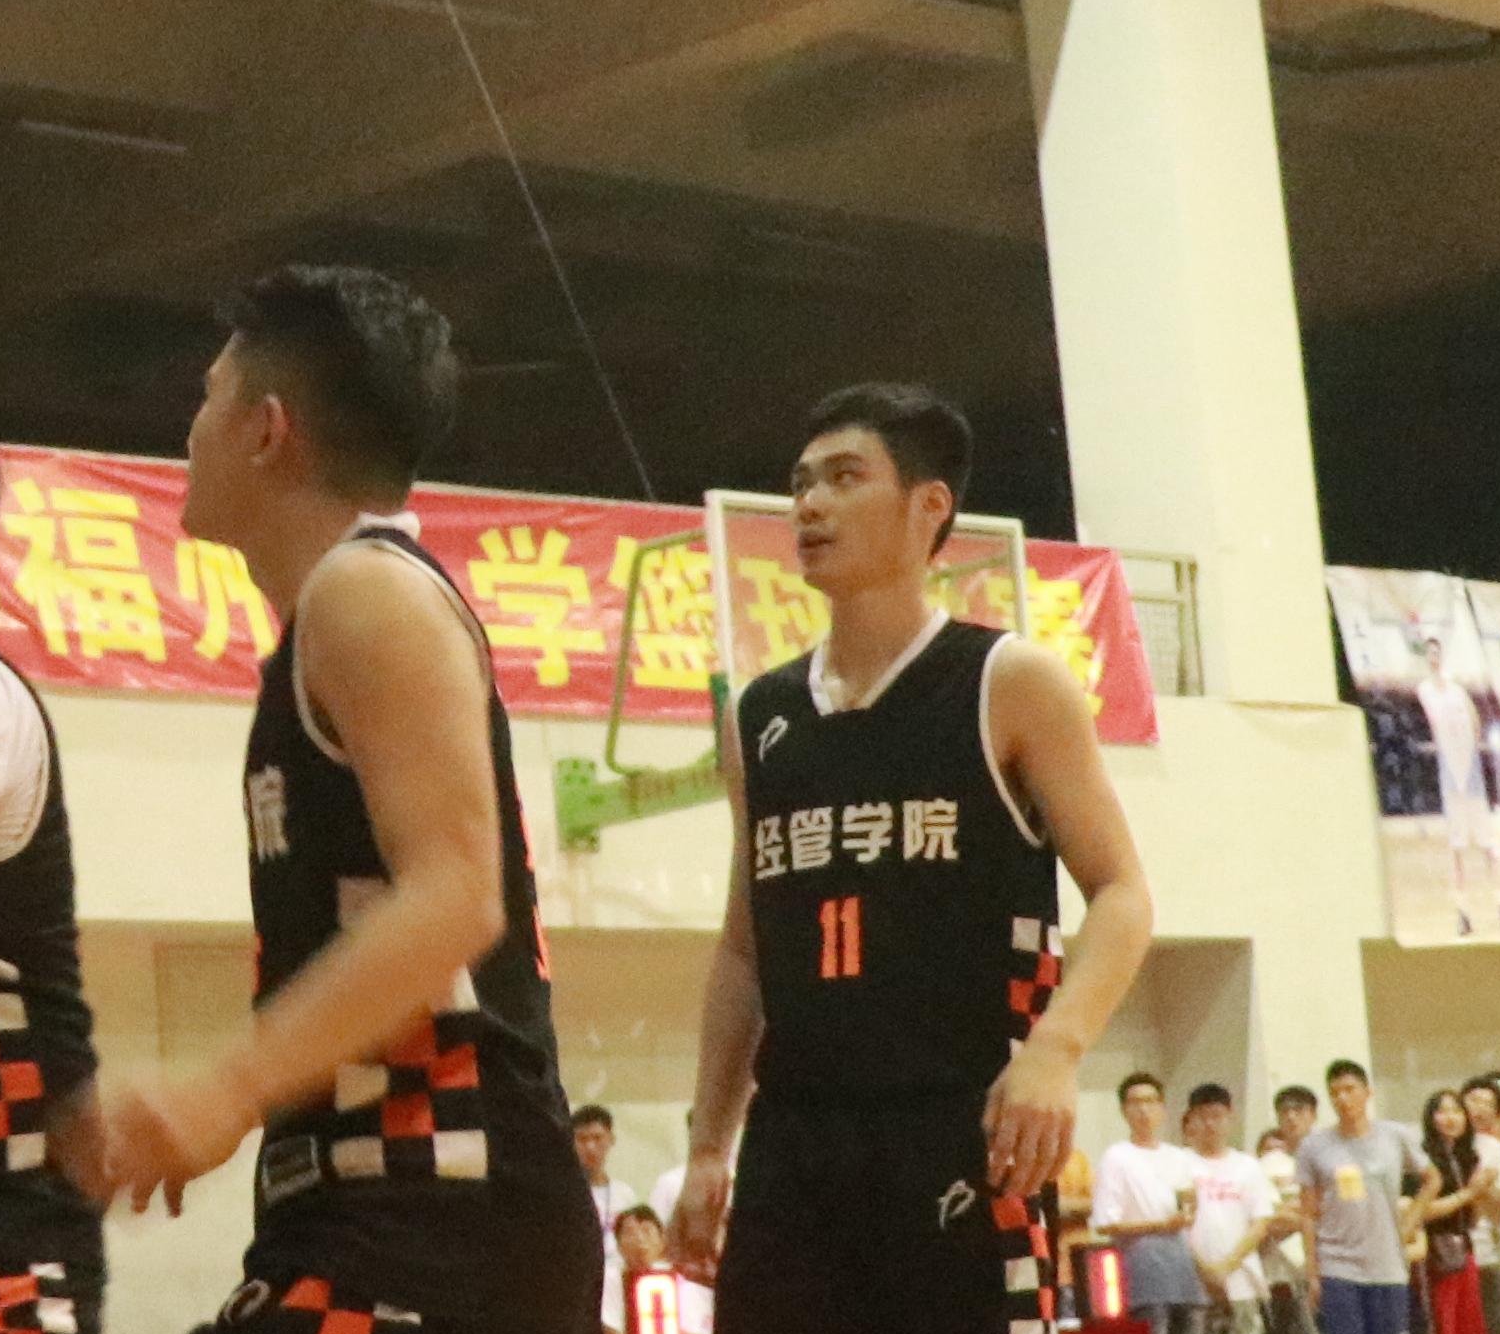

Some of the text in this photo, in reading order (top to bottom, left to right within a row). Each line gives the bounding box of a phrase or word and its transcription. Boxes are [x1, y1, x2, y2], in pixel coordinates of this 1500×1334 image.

[753, 798, 961, 880] 经管学院
[818, 896, 863, 978] 11
